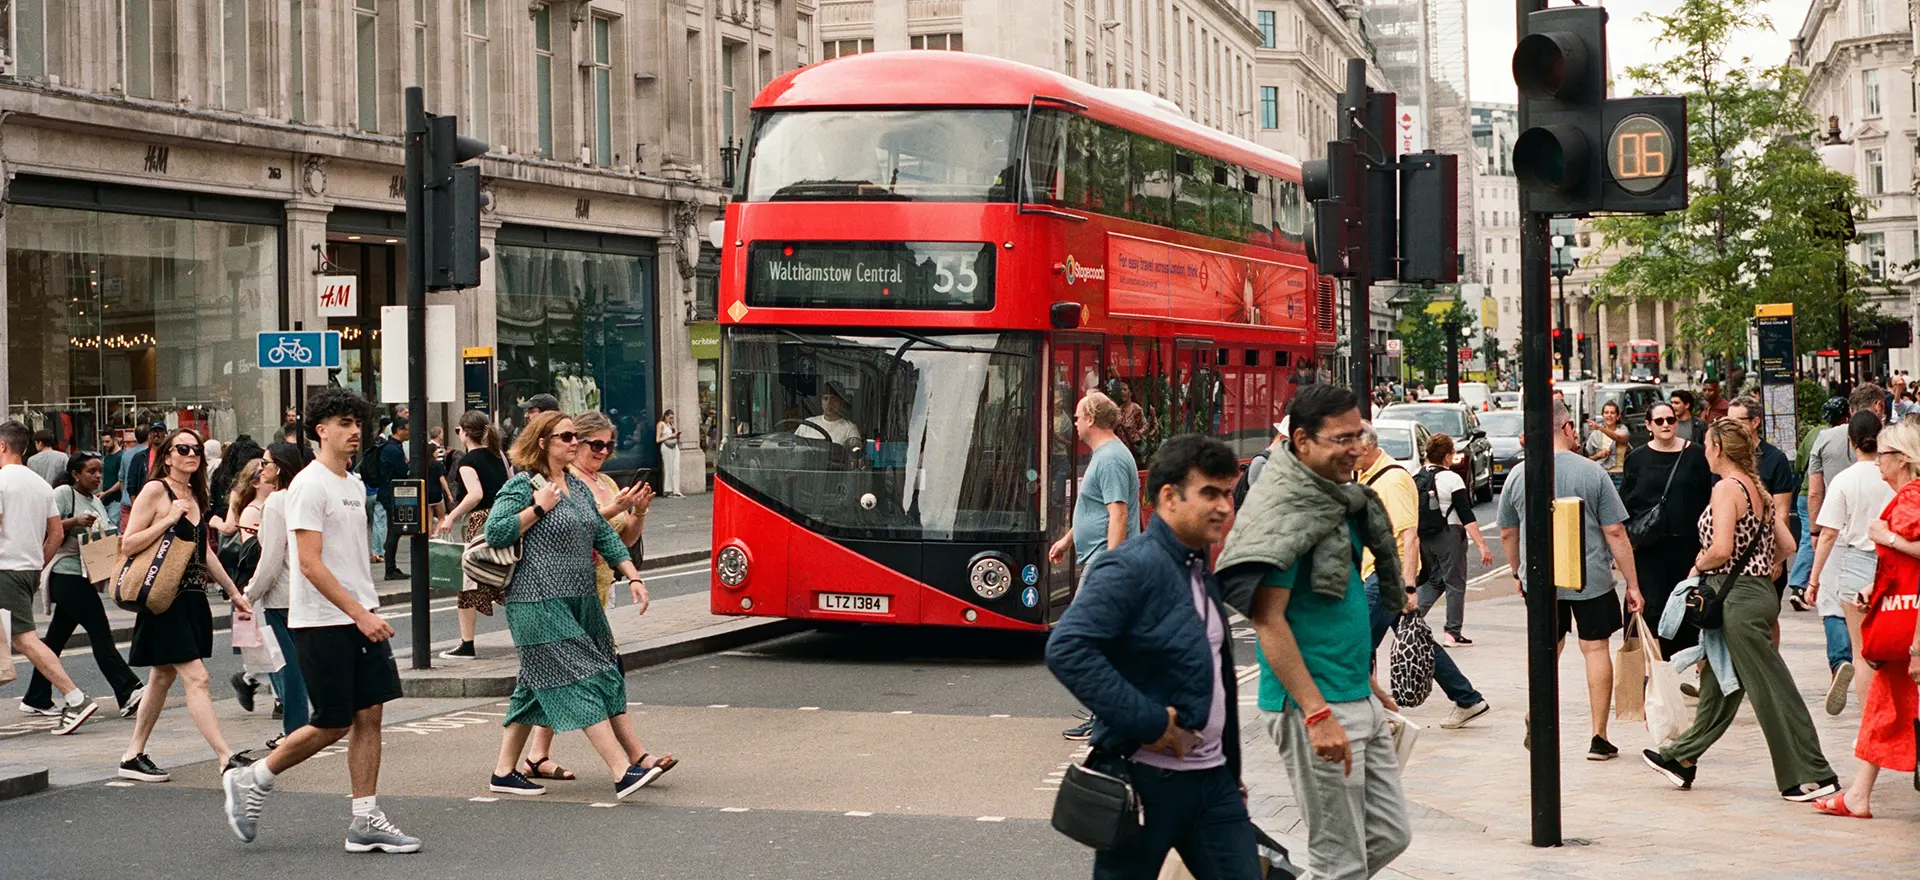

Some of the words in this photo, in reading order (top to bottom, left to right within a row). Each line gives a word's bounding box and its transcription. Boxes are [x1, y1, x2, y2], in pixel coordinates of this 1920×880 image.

[1617, 131, 1665, 178] 06
[268, 167, 282, 180] 263
[769, 261, 852, 282] Walthamstow
[856, 262, 903, 283] Central
[933, 254, 978, 293] 55
[1075, 262, 1105, 282] Stagecoach
[320, 284, 351, 308] H&M
[691, 337, 719, 346] scribbler
[826, 595, 850, 609] LTZ
[853, 597, 881, 611] 1384
